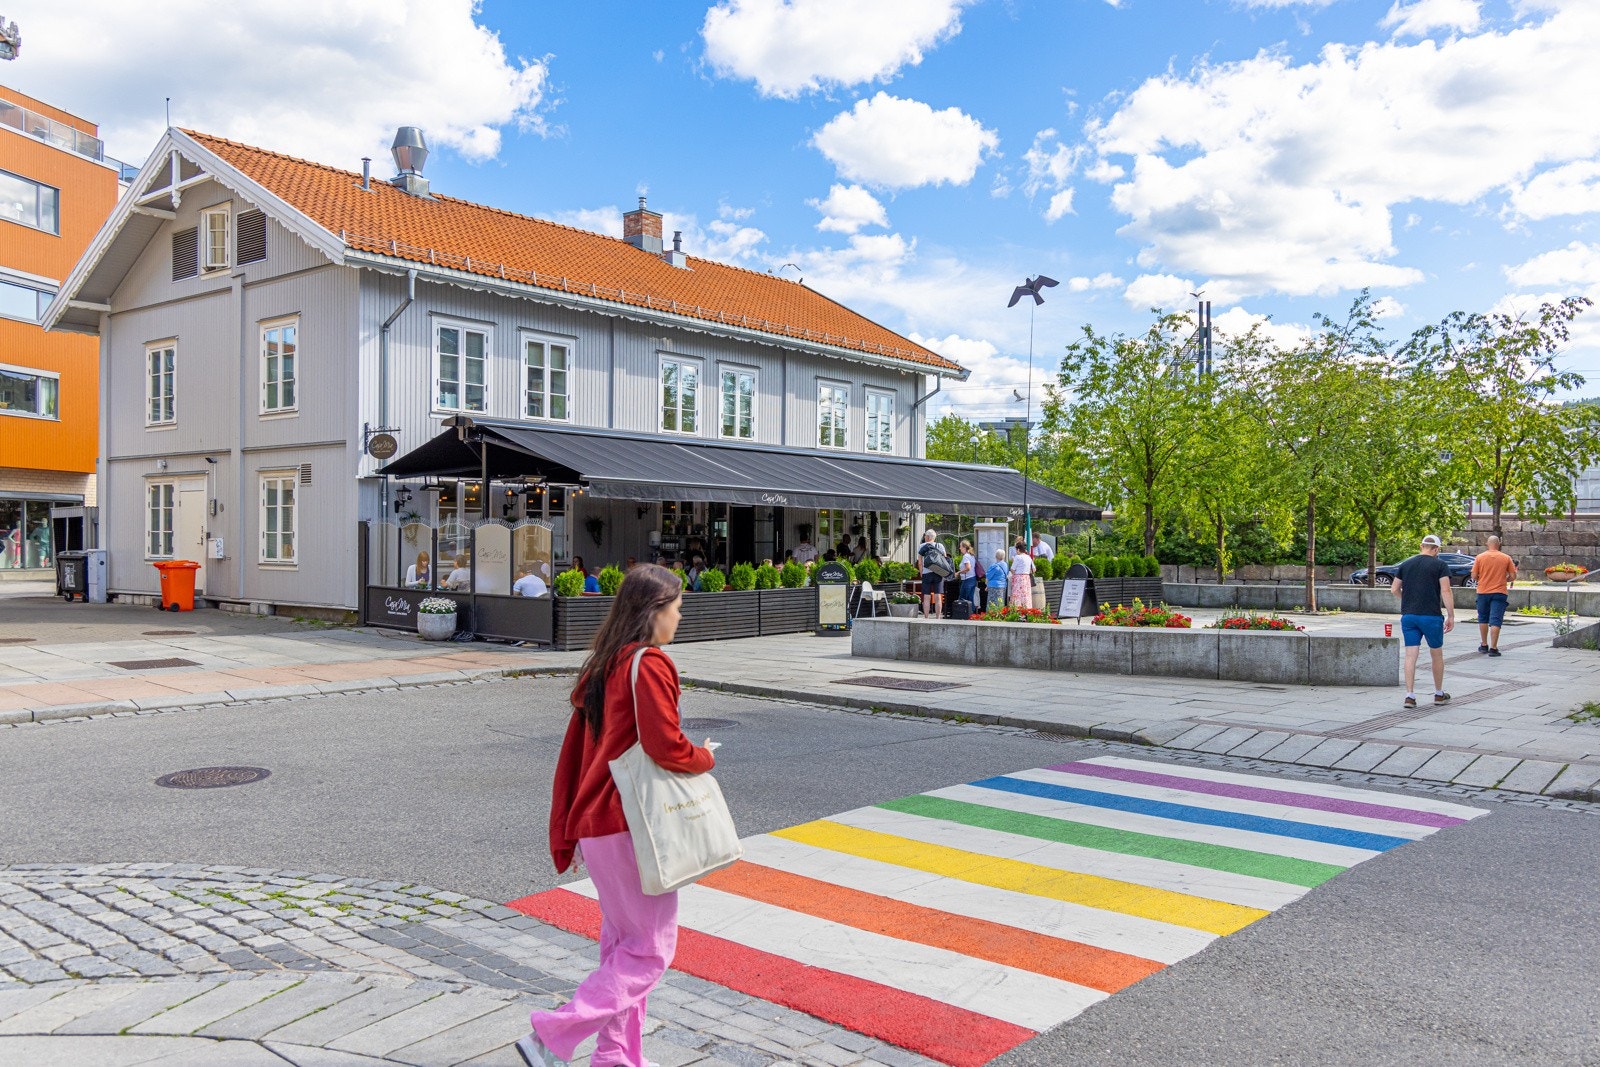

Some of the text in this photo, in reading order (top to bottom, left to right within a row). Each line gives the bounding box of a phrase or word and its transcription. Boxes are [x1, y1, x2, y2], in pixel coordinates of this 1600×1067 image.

[762, 493, 788, 505] Casa Mia
[385, 596, 411, 613] Casa Mia
